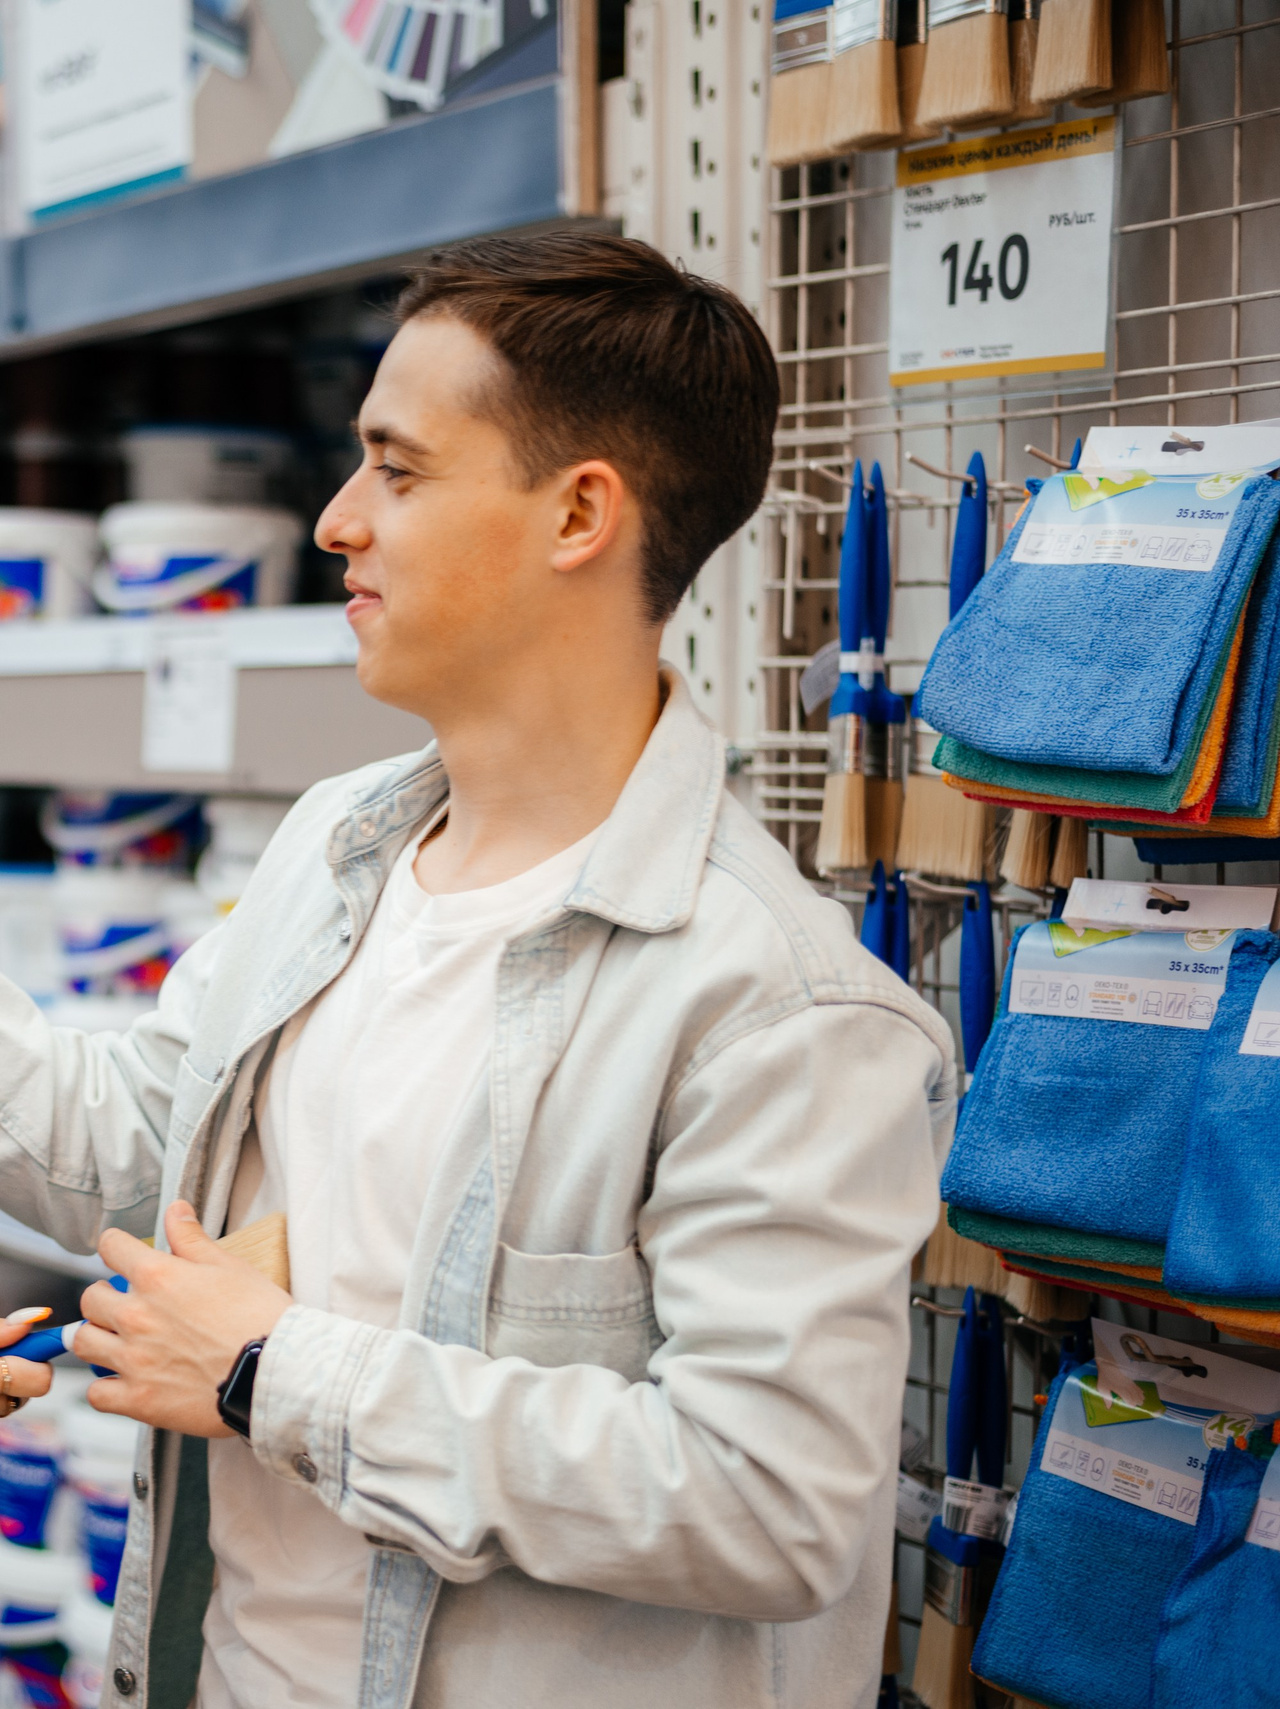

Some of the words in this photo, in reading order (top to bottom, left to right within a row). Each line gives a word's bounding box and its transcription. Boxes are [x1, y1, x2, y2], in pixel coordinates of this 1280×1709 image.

[958, 149, 993, 166] цены
[996, 133, 1054, 158] каждый
[1056, 126, 1098, 152] день!
[941, 233, 1029, 306] 140
[1176, 508, 1190, 519] 35
[1190, 511, 1196, 519] x
[1169, 961, 1182, 971] 35
[1183, 964, 1190, 972] x
[1186, 1456, 1200, 1468] 35
